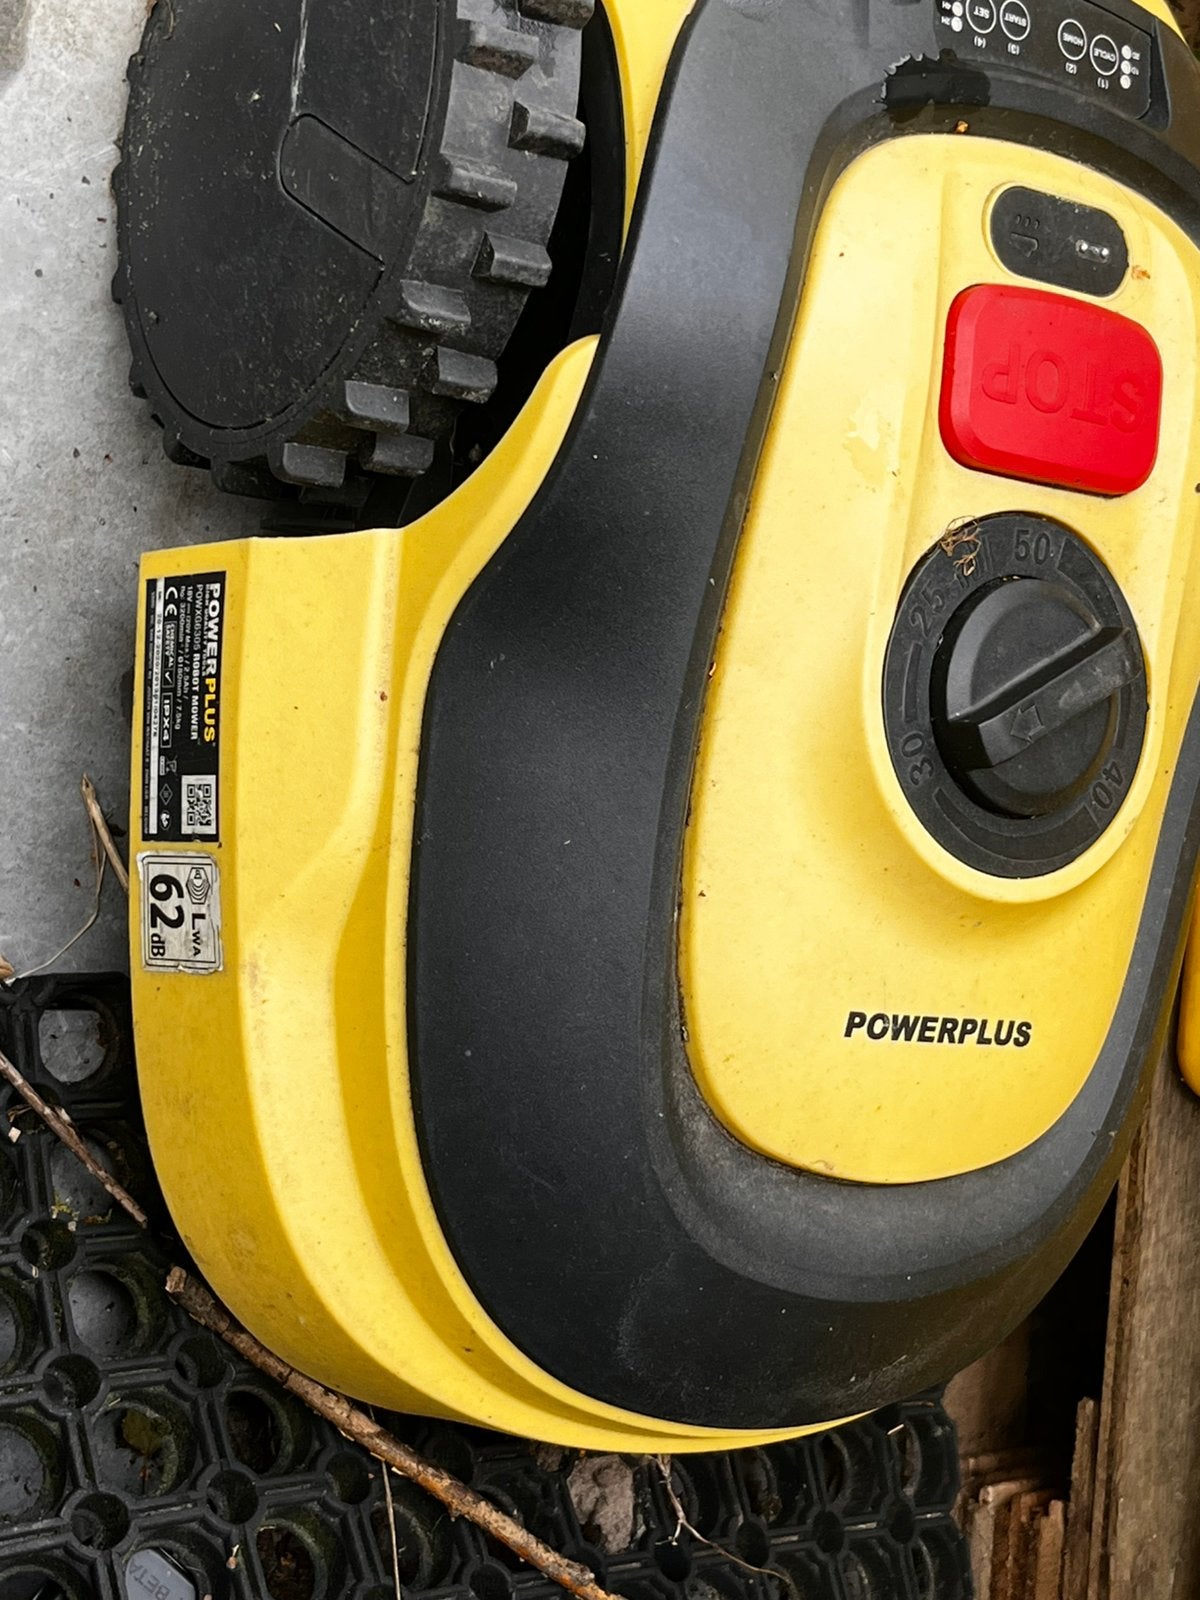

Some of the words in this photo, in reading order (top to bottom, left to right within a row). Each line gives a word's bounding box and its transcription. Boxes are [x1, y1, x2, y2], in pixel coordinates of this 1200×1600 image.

[973, 5, 990, 19] SET
[1003, 12, 1027, 27] START
[974, 36, 987, 49] (4)
[1007, 42, 1020, 55] (3)
[1062, 32, 1084, 47] HOME
[1093, 47, 1116, 62] CYCLE
[1065, 62, 1077, 75] (2)
[1097, 77, 1109, 90] (1)
[980, 344, 1147, 435] STOP
[1013, 528, 1050, 566] 50
[909, 585, 945, 638] 25
[191, 653, 201, 692] ROBOT
[204, 583, 221, 742] POWERPLUS
[162, 699, 171, 742] IPX4
[190, 695, 199, 740] MOWER
[900, 731, 935, 788] 30
[1091, 760, 1125, 811] 40
[149, 874, 185, 929] 62
[150, 933, 166, 957] dB
[843, 1011, 1032, 1047] POWERPLUS
